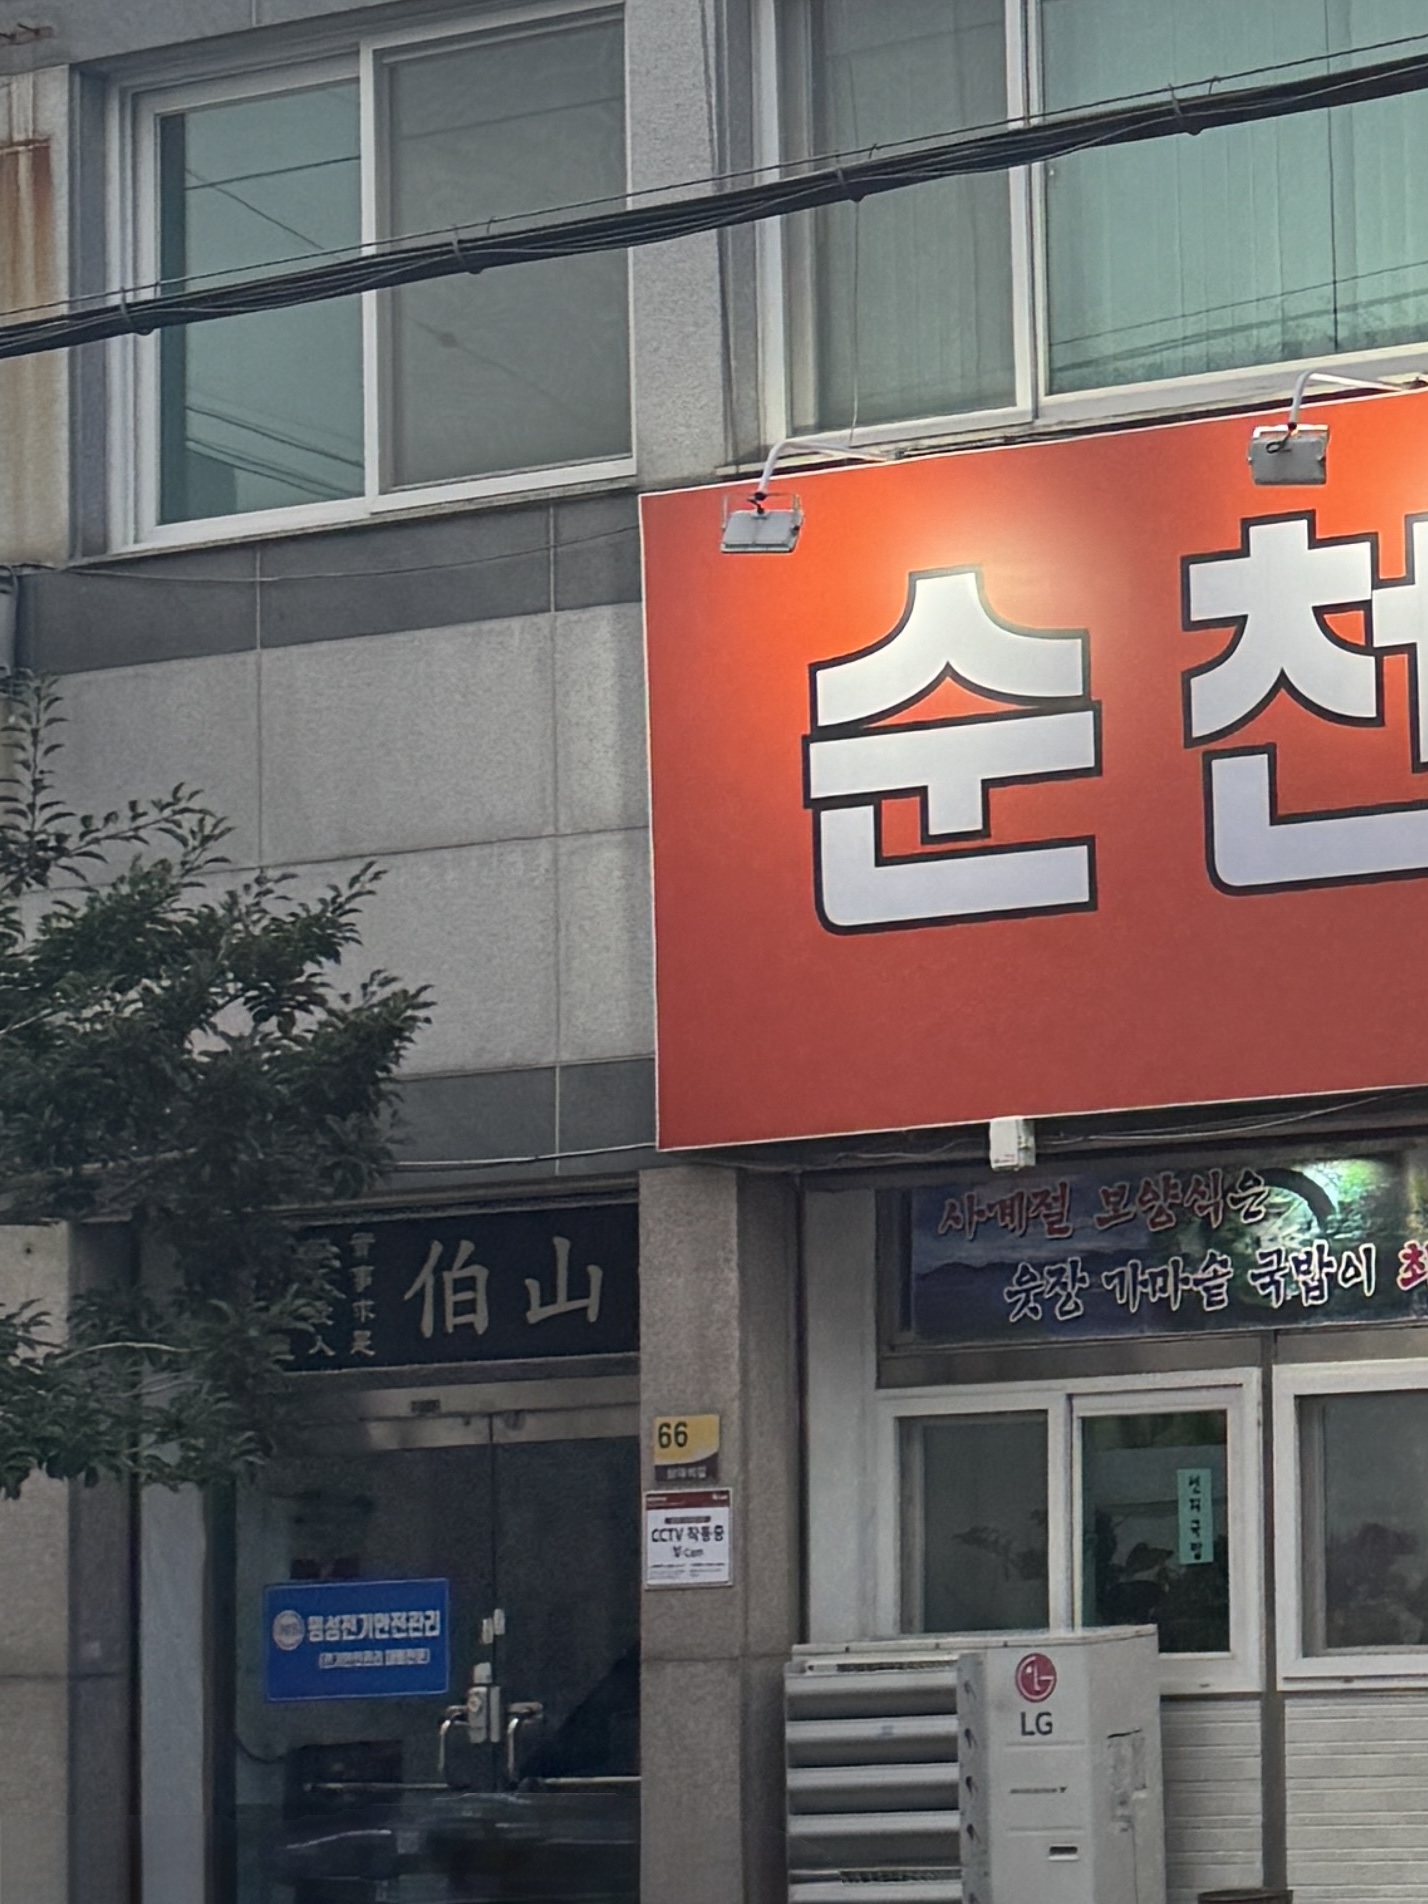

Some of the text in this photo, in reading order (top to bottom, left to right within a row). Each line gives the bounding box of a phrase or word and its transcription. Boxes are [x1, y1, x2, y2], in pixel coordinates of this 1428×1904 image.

[937, 1181, 1073, 1240] 사계절
[1004, 1256, 1090, 1323] 웃장
[1102, 1249, 1233, 1314] 가마솥
[1247, 1238, 1377, 1309] 국밥이
[657, 1421, 689, 1449] 66
[651, 1527, 684, 1543] CCTV
[1020, 1711, 1054, 1737] LG
